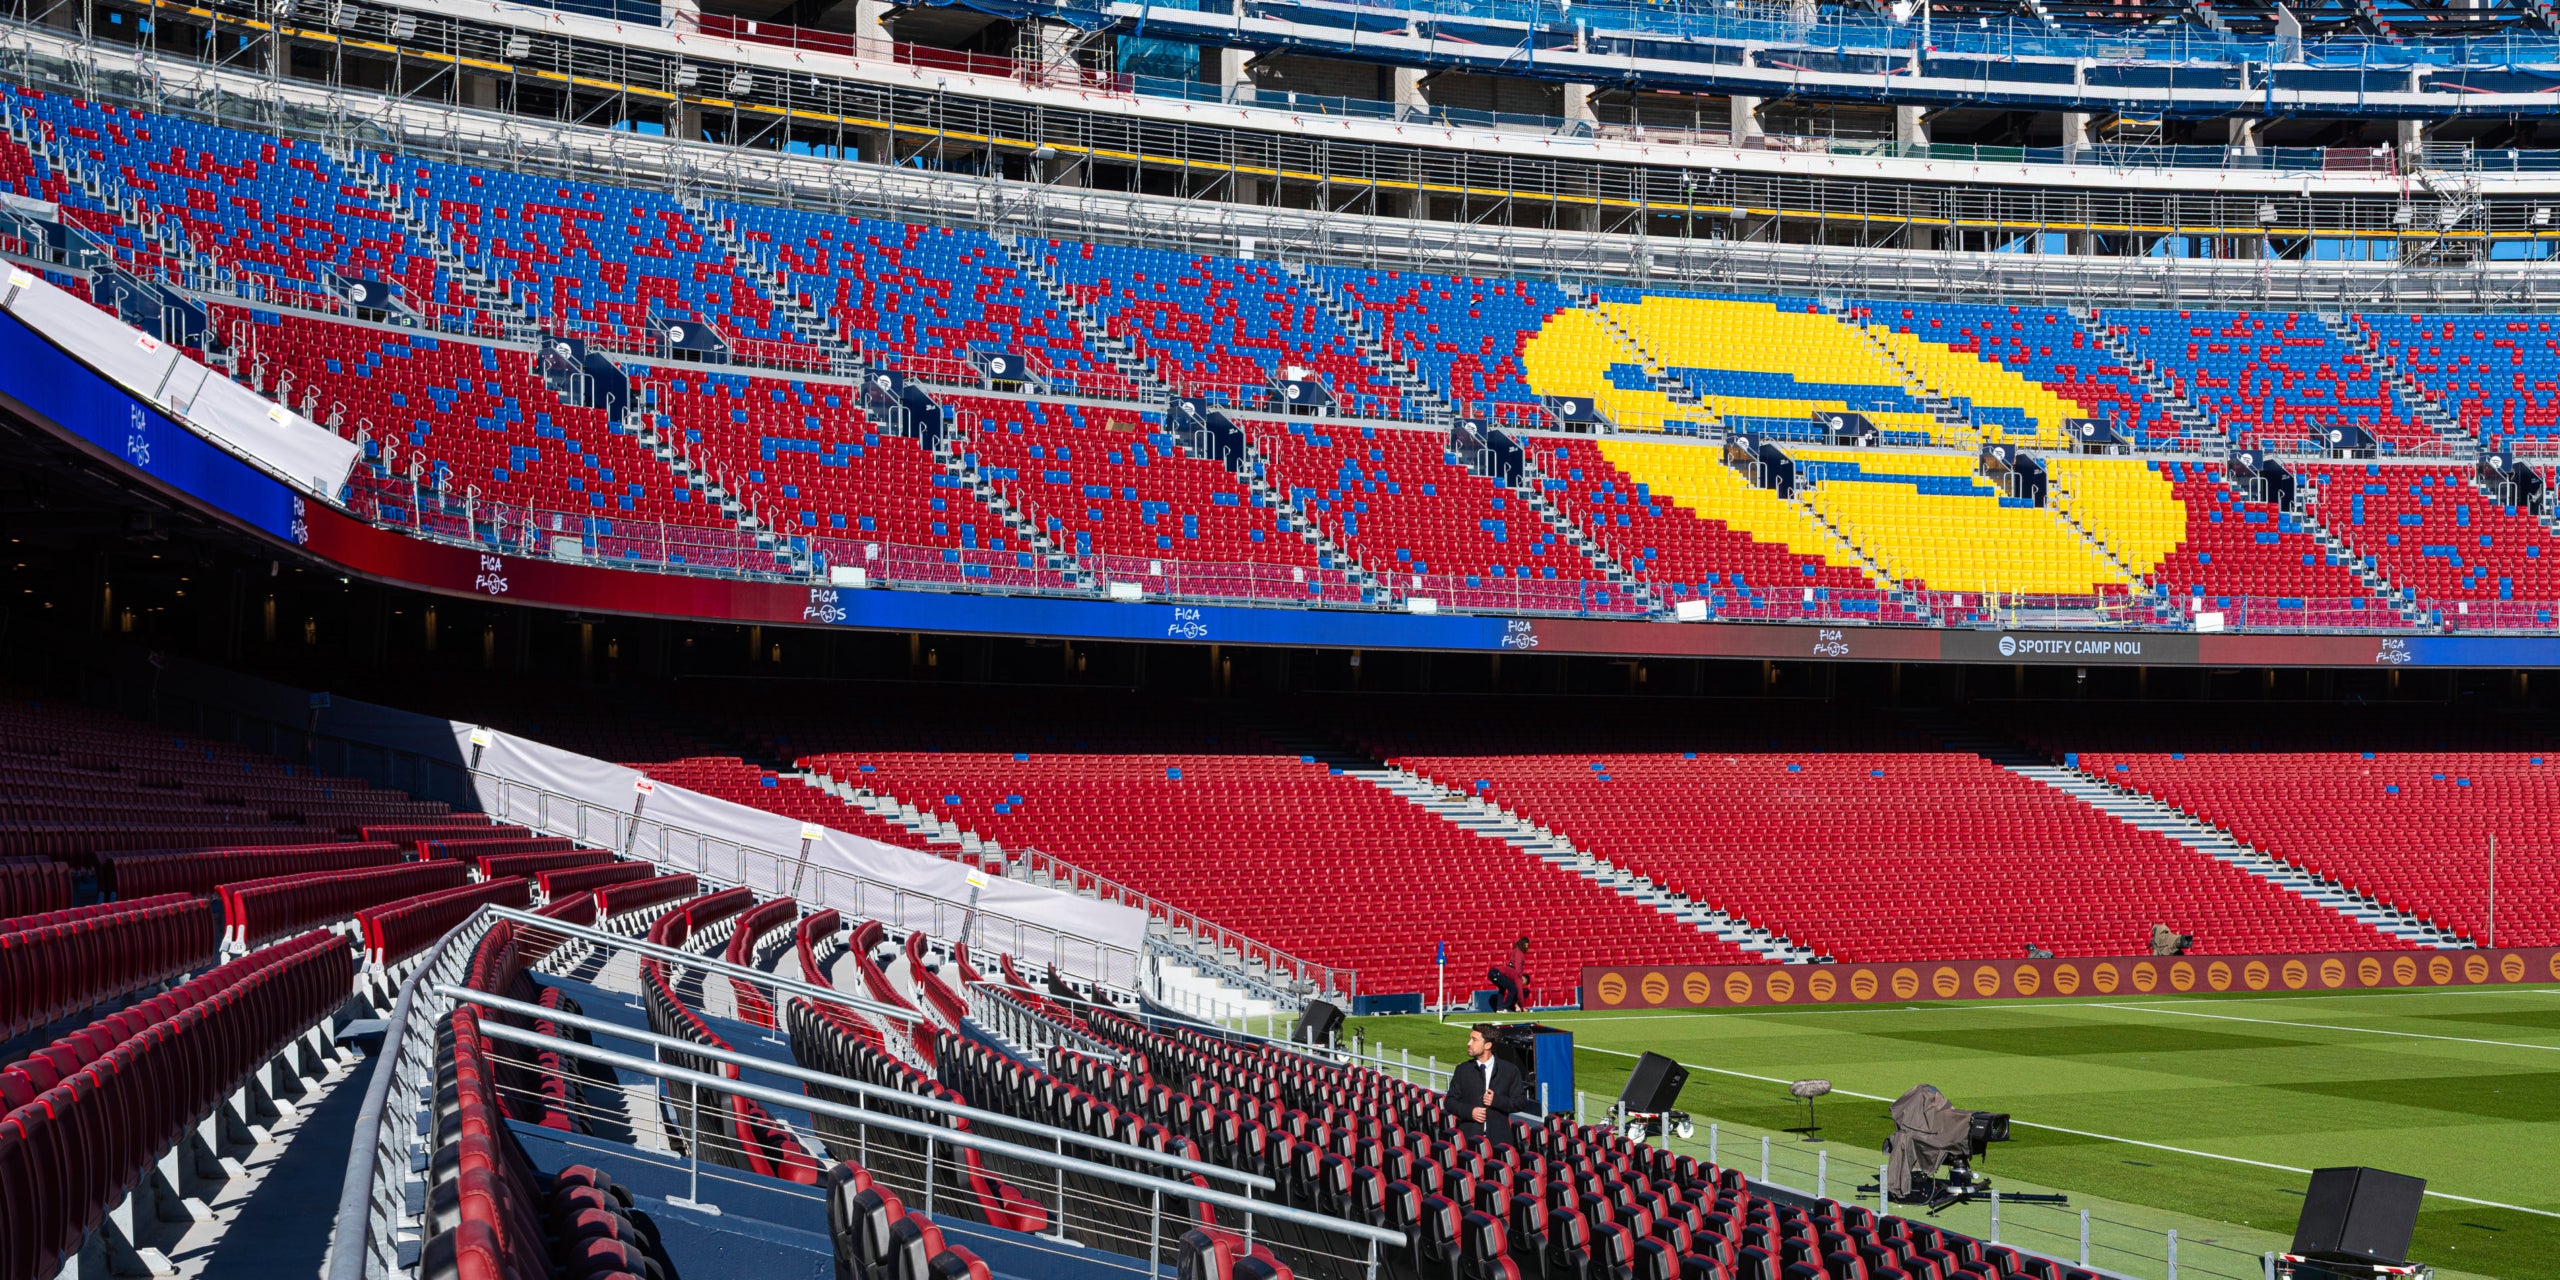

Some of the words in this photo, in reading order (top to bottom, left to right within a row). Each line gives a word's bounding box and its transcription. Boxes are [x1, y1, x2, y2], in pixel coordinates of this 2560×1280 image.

[480, 554, 502, 571] FIGA
[810, 588, 839, 603] FIGA
[1174, 607, 1201, 621] FIGA
[1508, 620, 1532, 632] FIGA
[1819, 629, 1843, 641] FIGA
[2018, 639, 2072, 654] SPOTIFY
[2074, 640, 2111, 655] CAMP
[2114, 641, 2141, 655] NOU
[2382, 638, 2405, 650] FIGA
